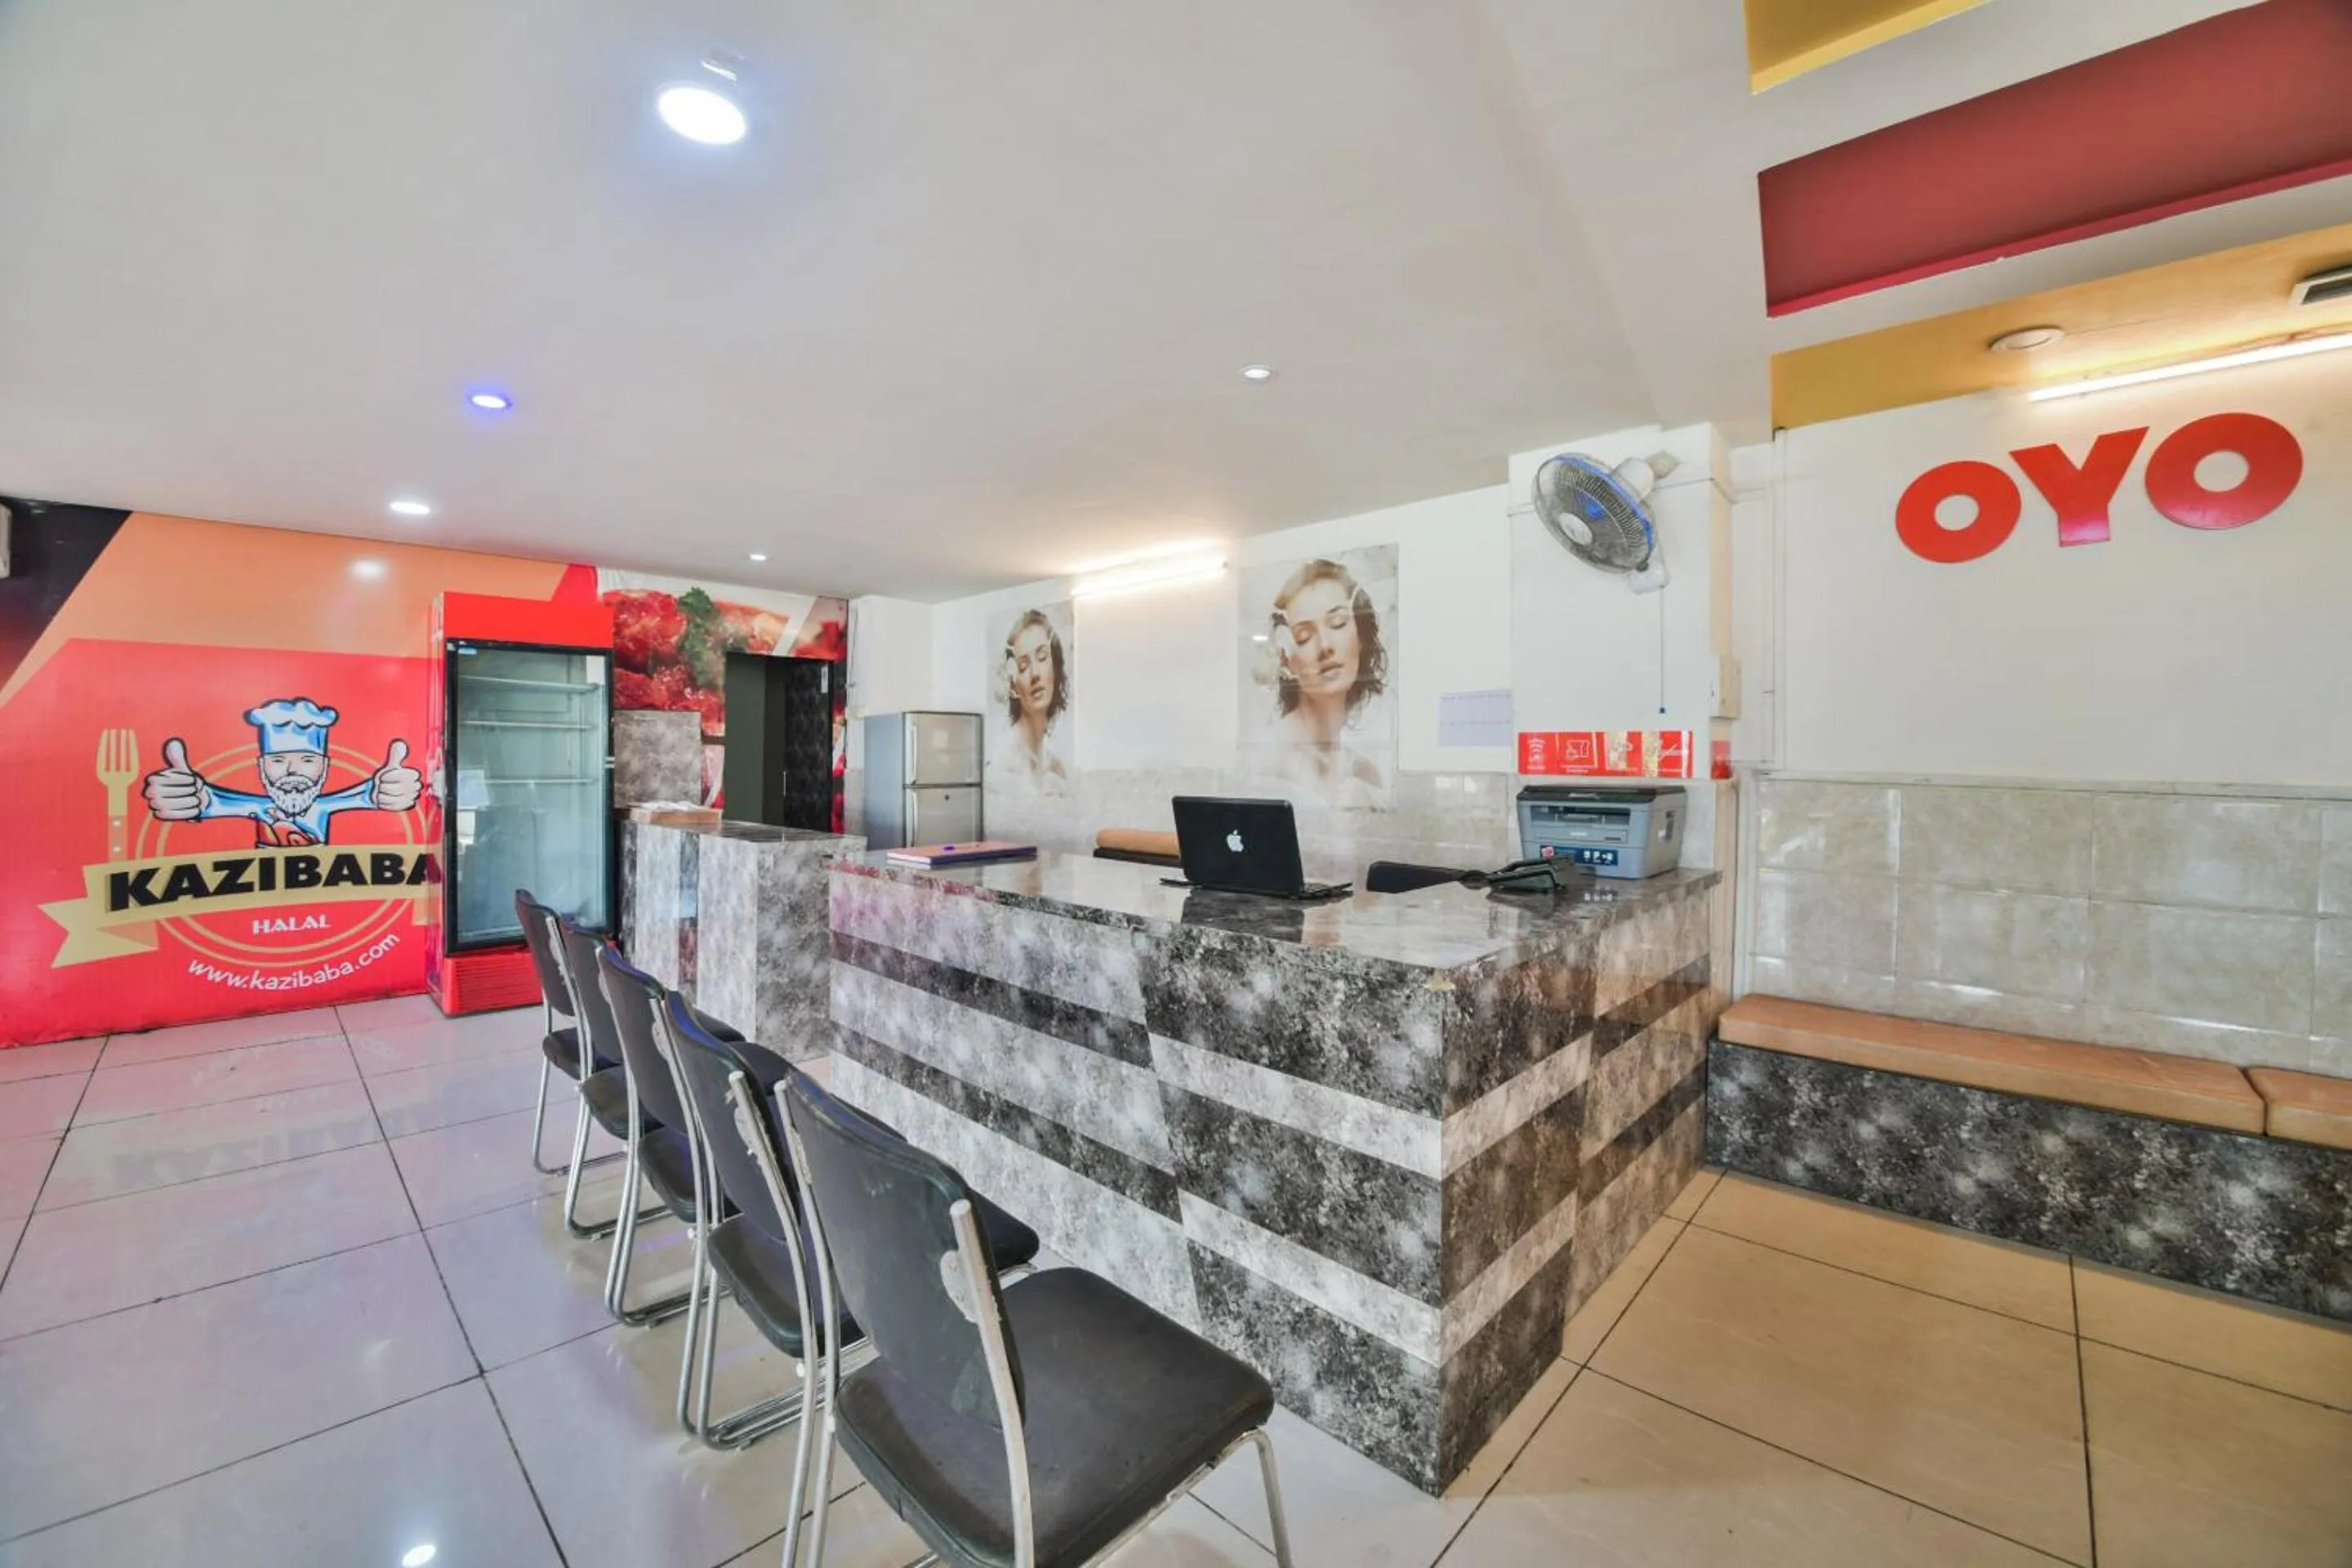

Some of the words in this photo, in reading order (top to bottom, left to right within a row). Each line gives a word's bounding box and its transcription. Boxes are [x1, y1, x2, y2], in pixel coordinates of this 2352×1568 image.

[1895, 412, 2303, 564] OYO
[252, 914, 331, 934] HALAL
[187, 933, 401, 991] www.kazibaba.com
